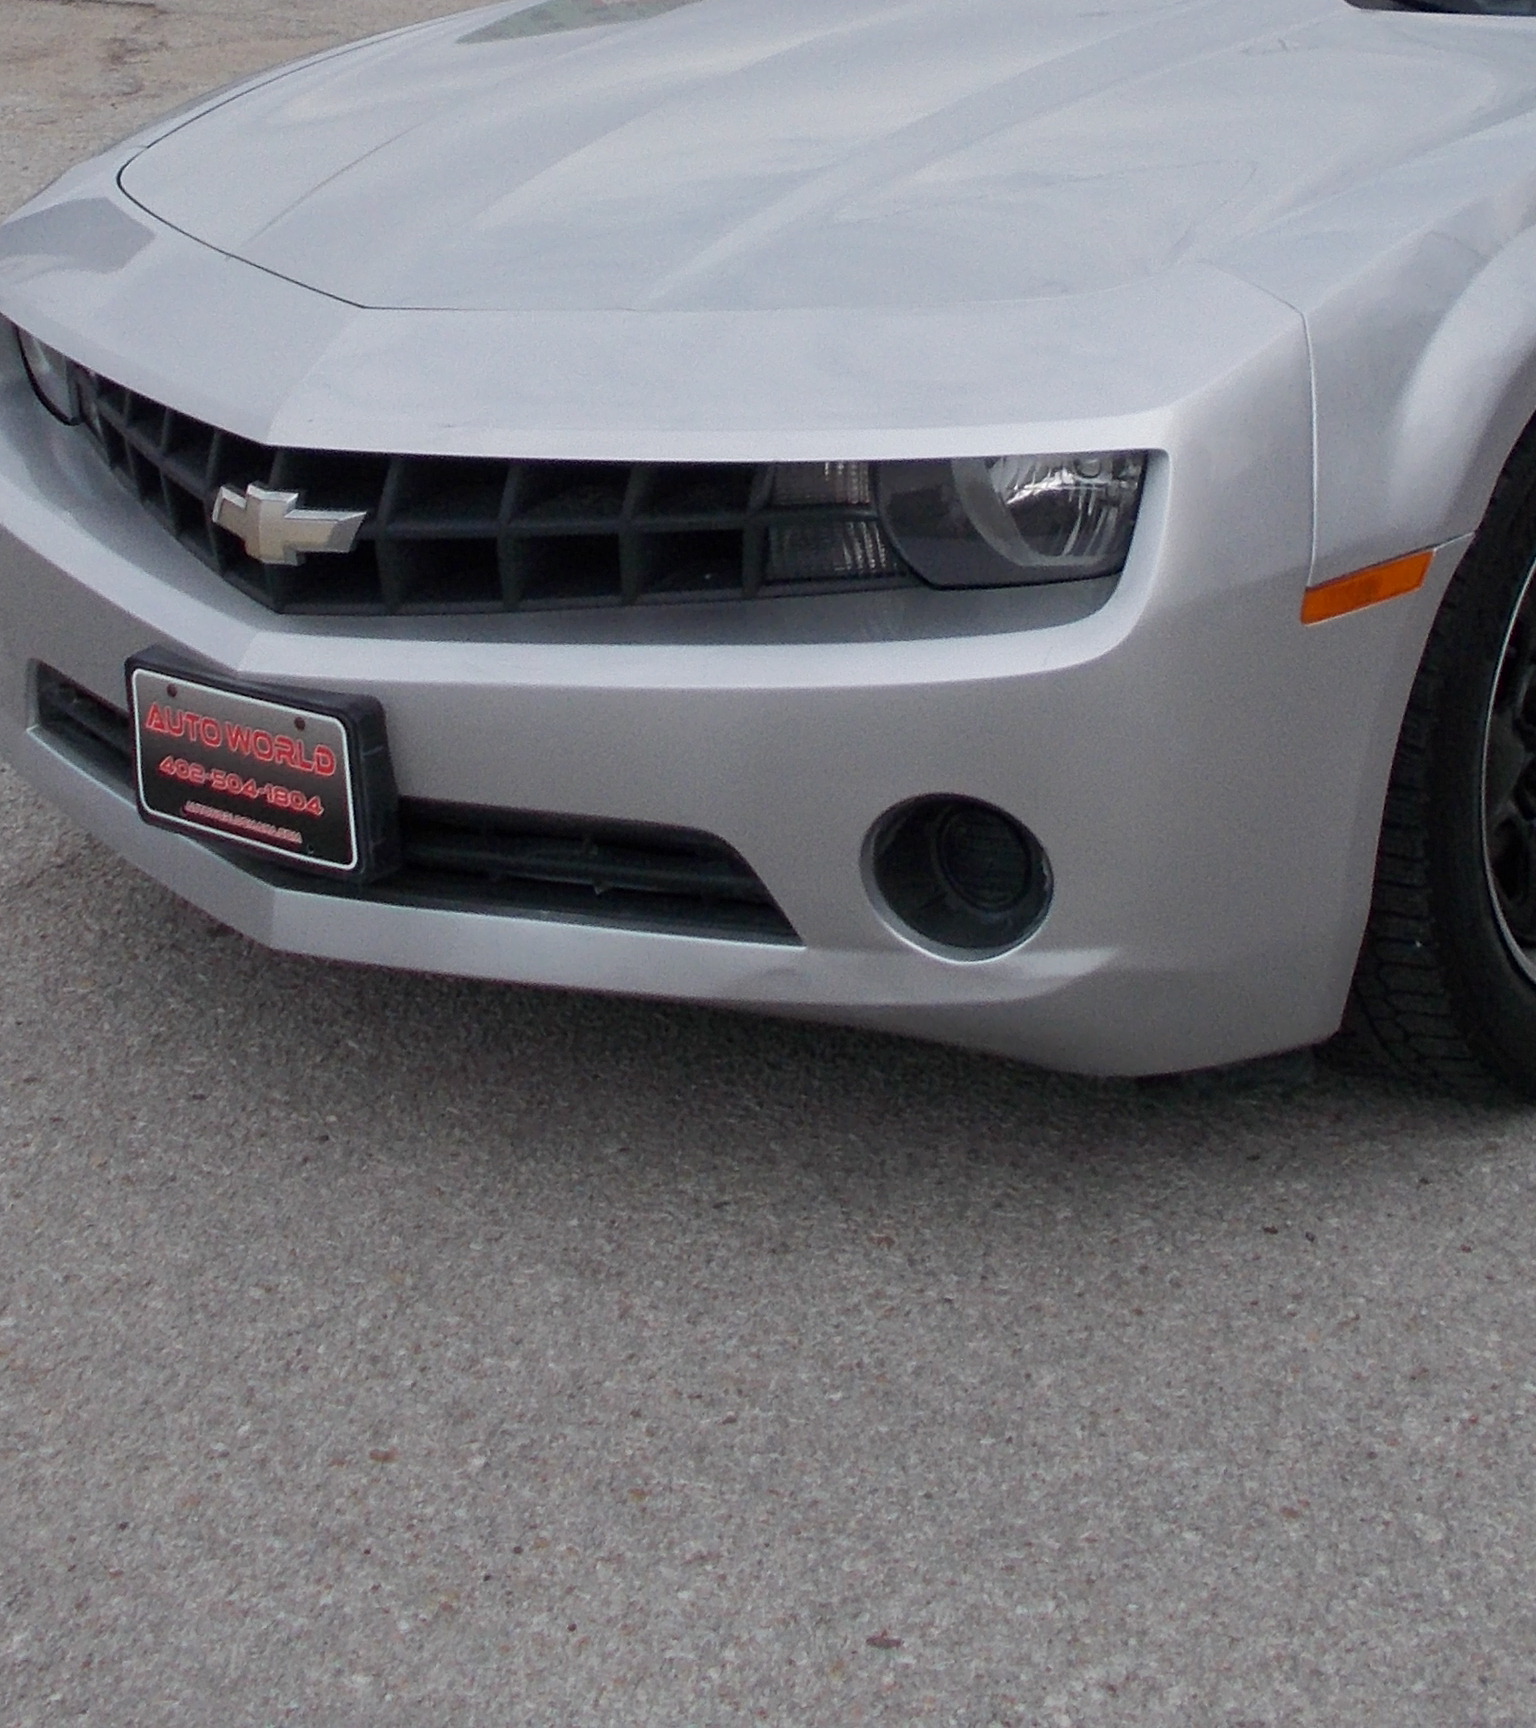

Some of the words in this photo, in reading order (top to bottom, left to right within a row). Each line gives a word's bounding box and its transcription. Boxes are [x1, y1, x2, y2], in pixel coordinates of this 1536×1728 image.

[146, 703, 221, 748] AUTO
[226, 723, 336, 776] WORLD
[158, 755, 325, 817] 402-504-1804
